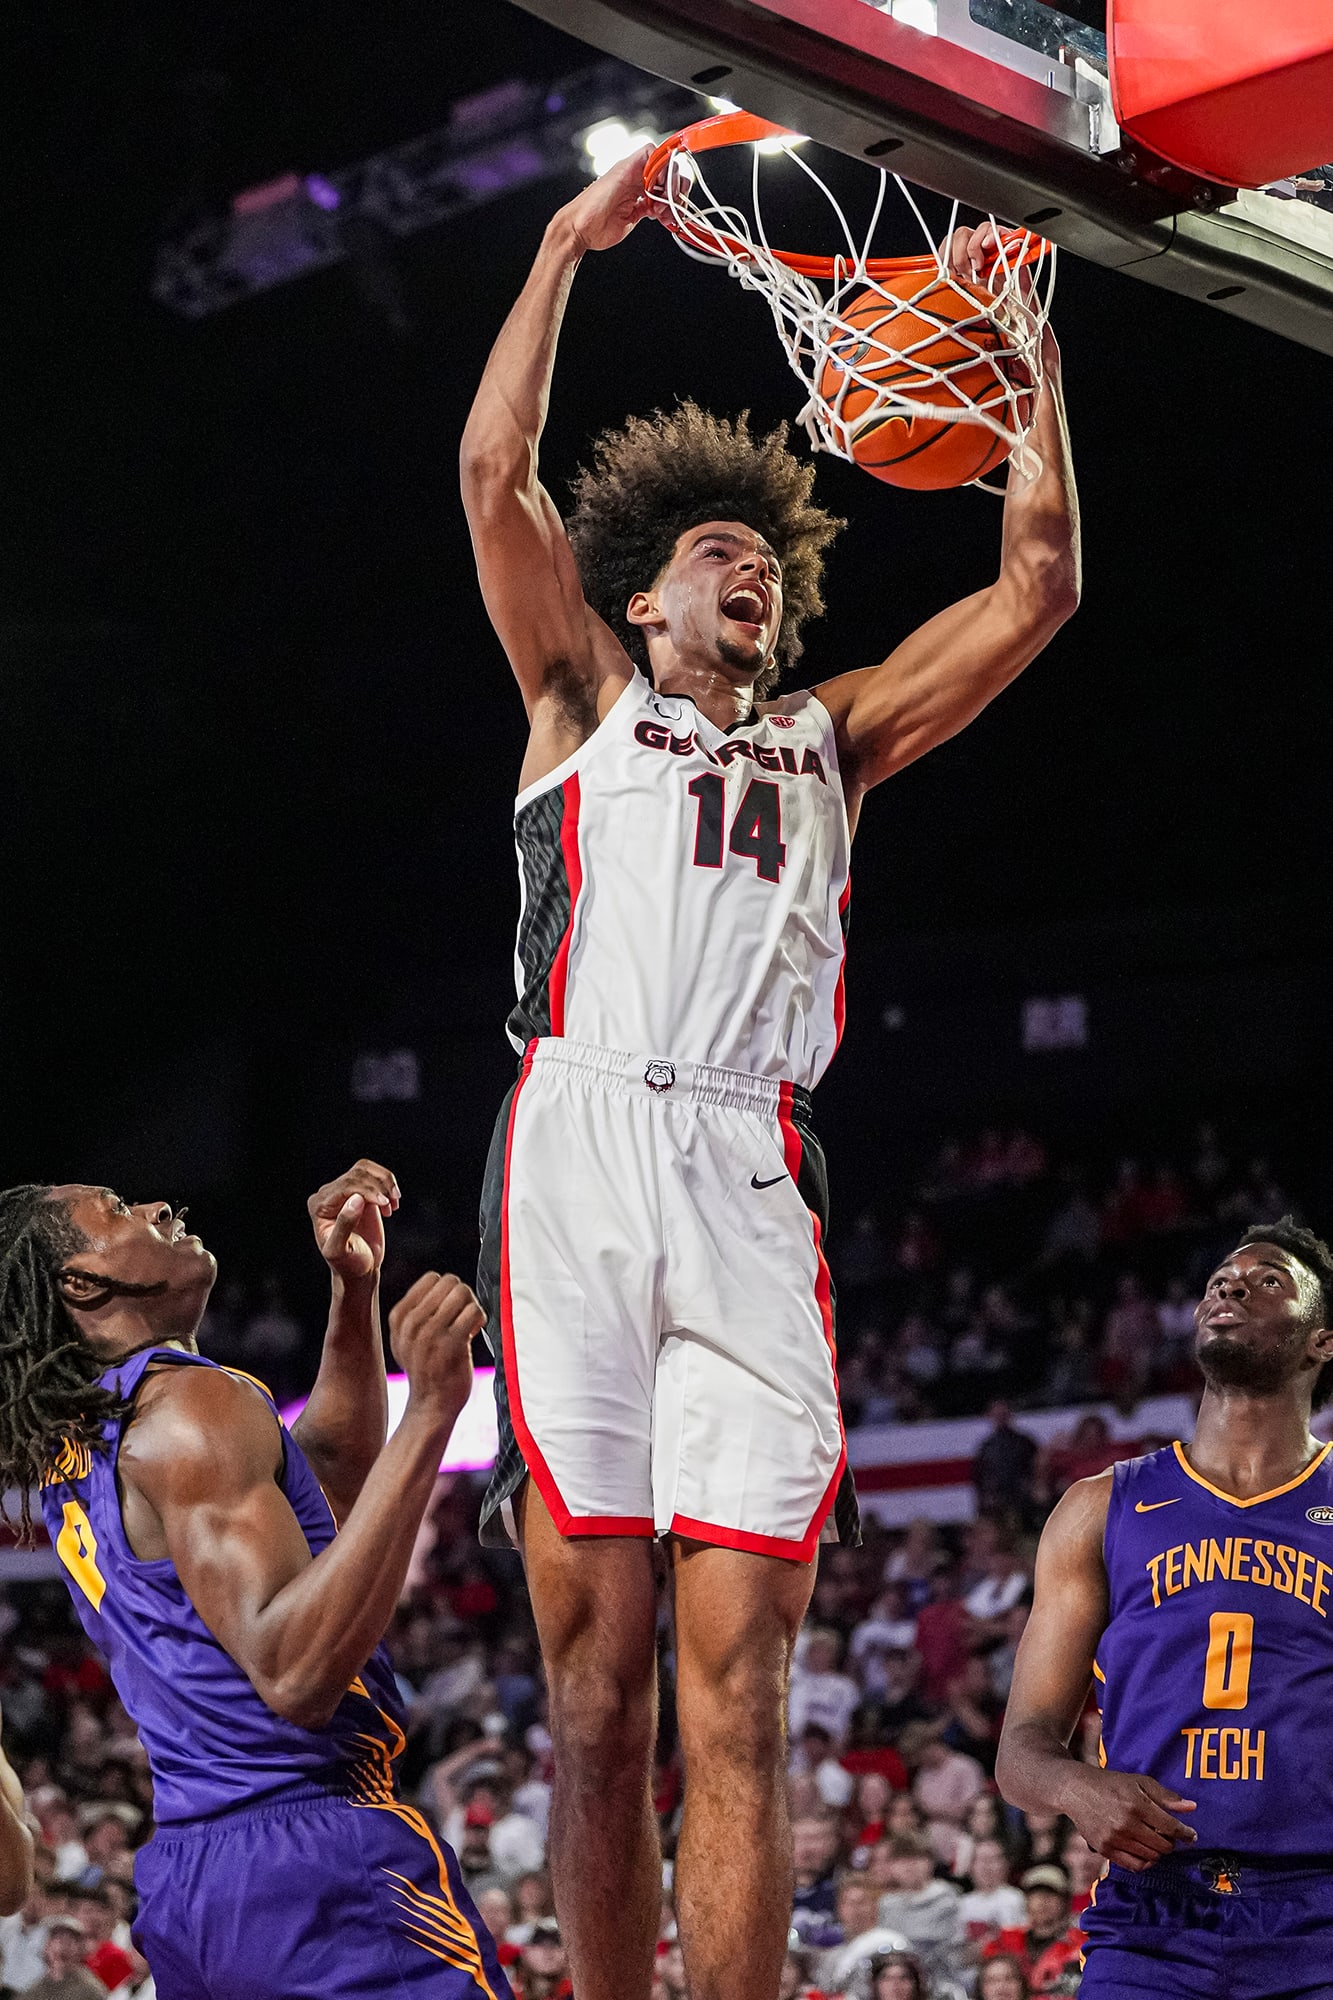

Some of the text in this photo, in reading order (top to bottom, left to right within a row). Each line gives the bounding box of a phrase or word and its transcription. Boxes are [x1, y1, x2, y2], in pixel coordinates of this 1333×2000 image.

[770, 716, 794, 728] SEC
[688, 771, 787, 884] 14
[1146, 1537, 1333, 1618] TENNESSEE
[1202, 1612, 1255, 1710] 0
[1181, 1727, 1266, 1782] TECH
